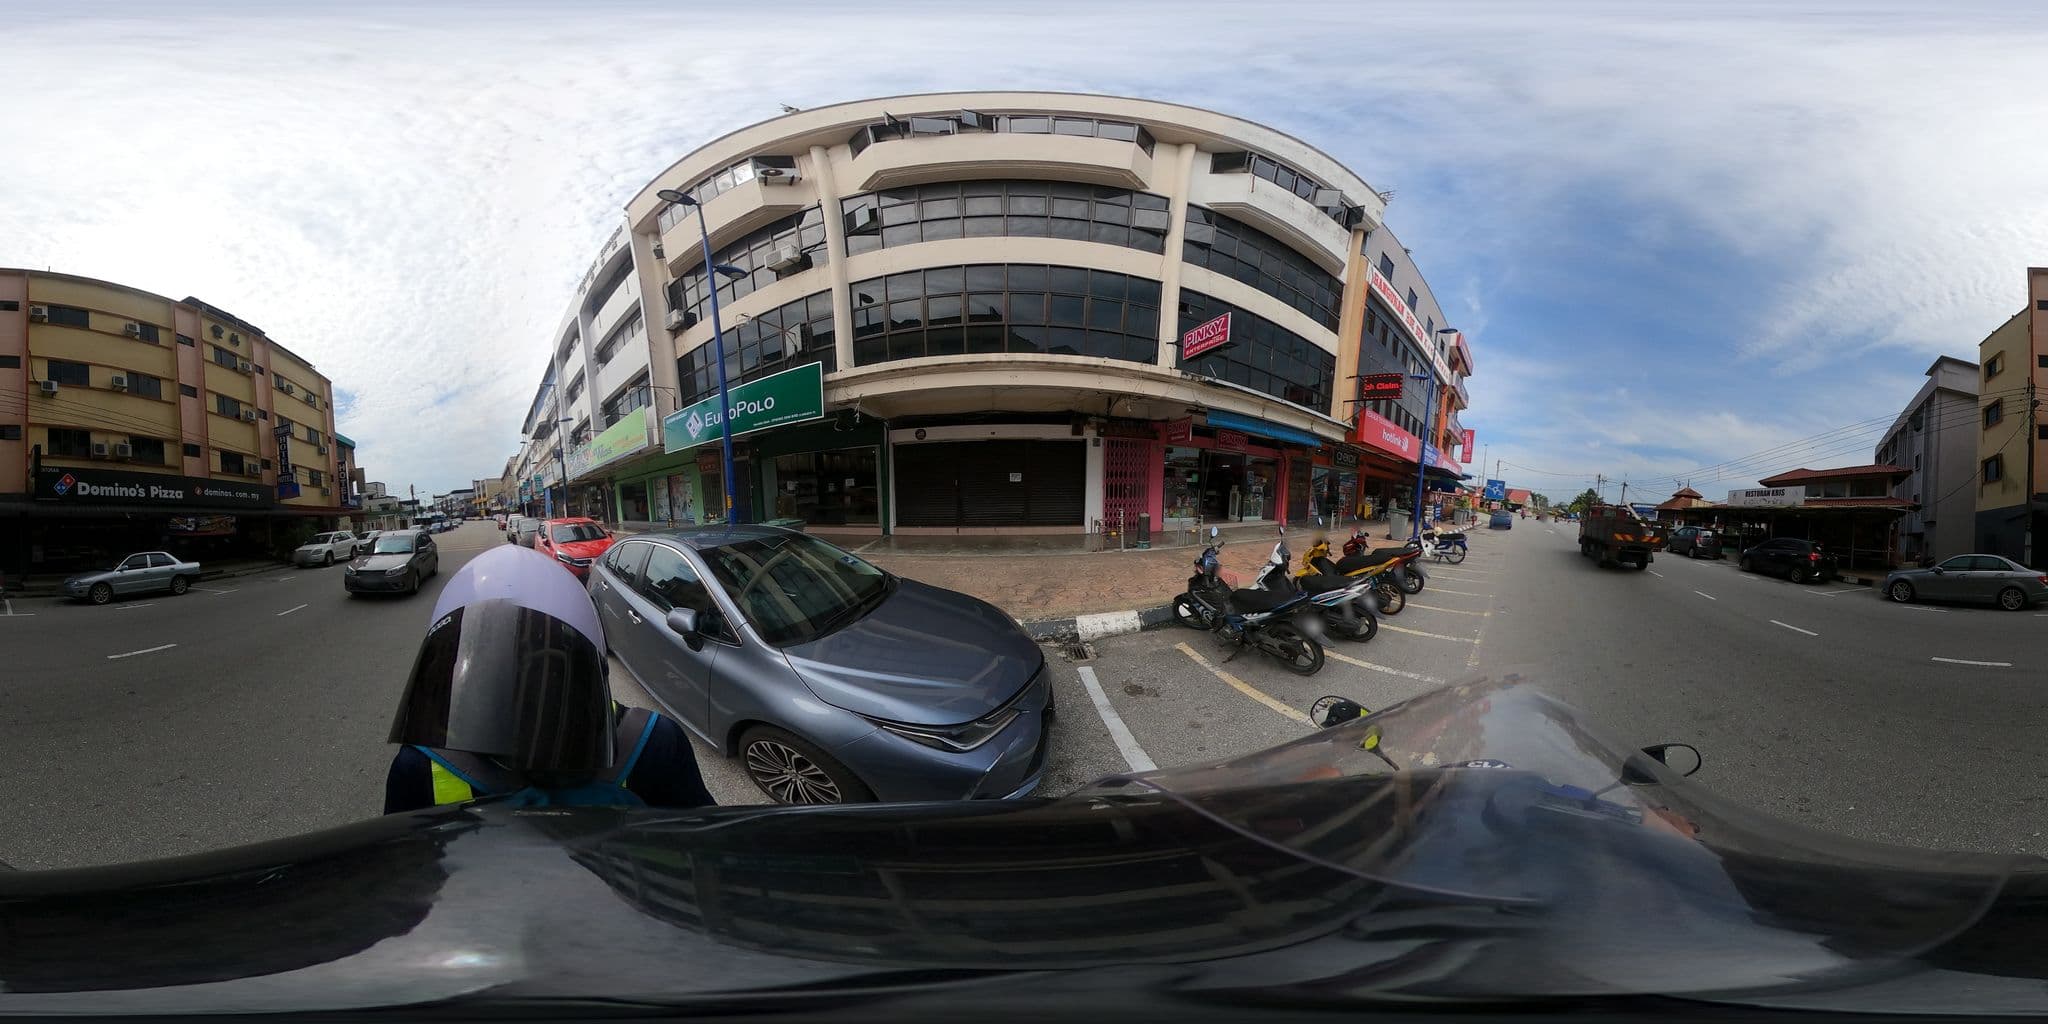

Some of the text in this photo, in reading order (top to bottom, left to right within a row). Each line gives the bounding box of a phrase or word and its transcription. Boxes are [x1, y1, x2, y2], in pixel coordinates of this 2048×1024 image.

[1185, 317, 1225, 348] PINKY
[1186, 334, 1226, 355] ENTERPRISE
[1377, 382, 1399, 390] Claim
[77, 482, 184, 499] Domino's Pizza
